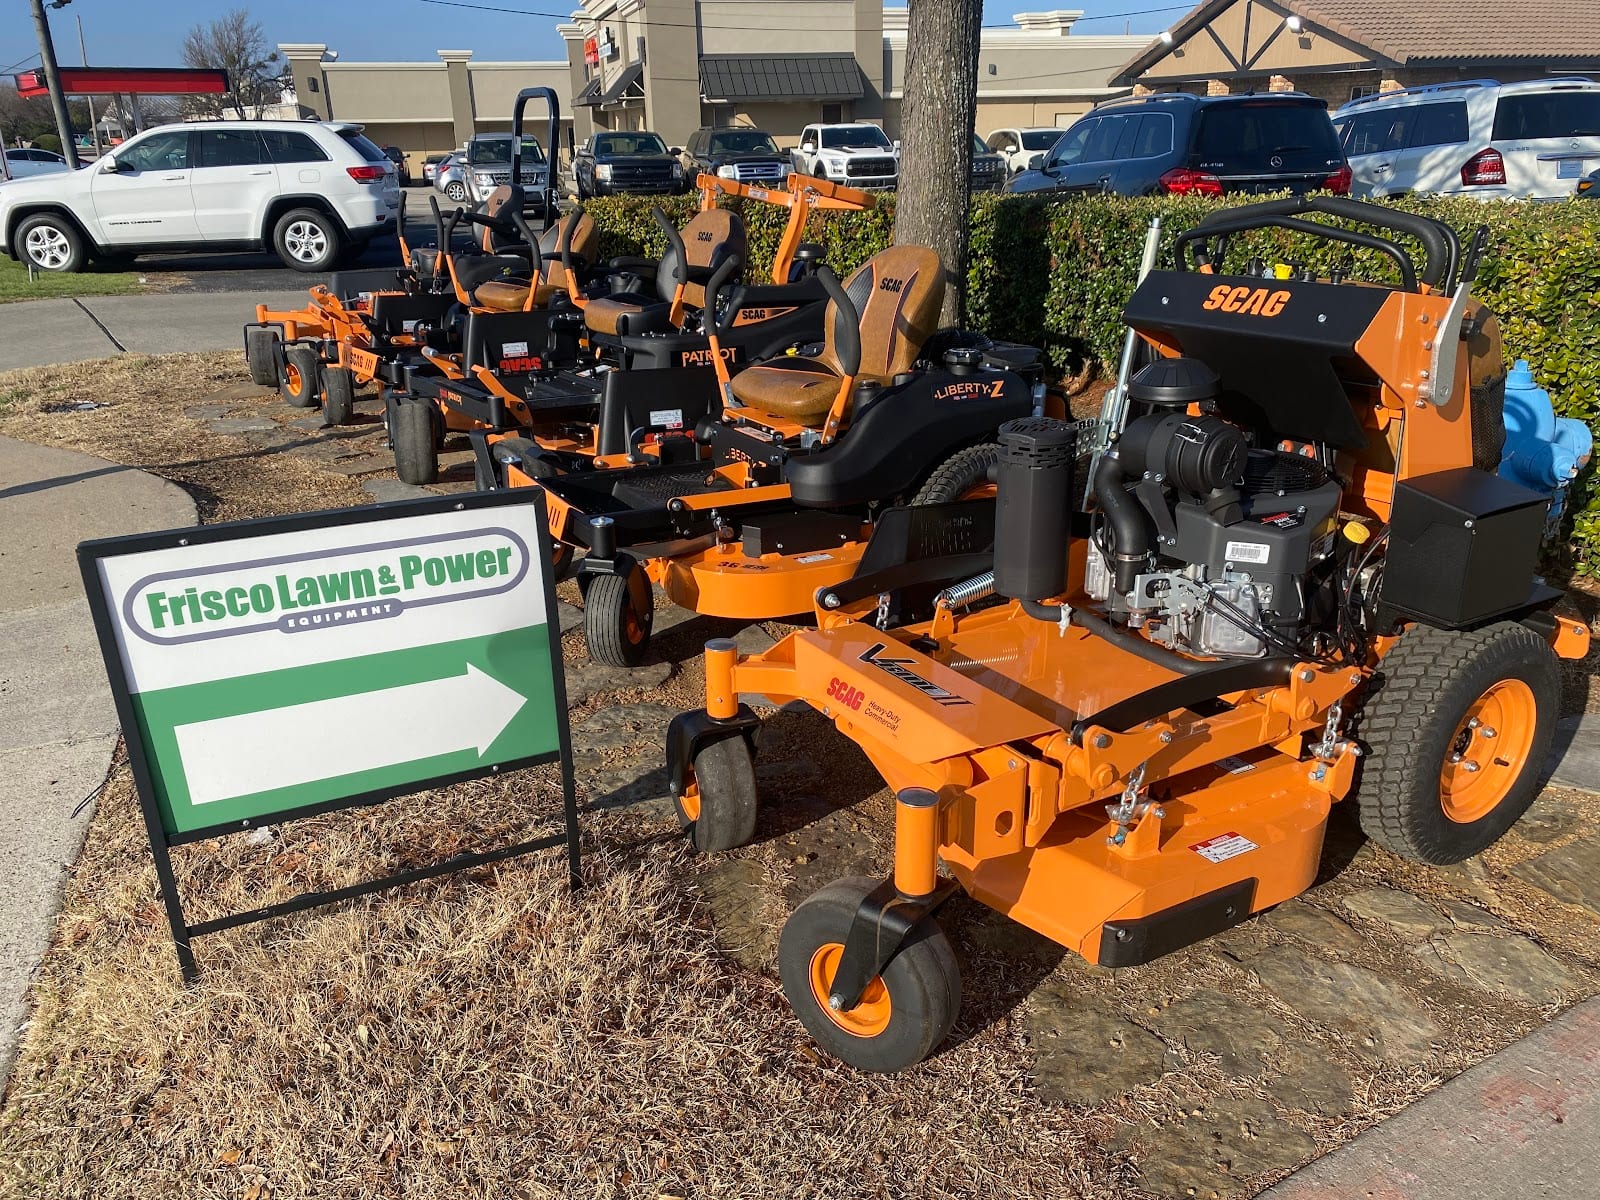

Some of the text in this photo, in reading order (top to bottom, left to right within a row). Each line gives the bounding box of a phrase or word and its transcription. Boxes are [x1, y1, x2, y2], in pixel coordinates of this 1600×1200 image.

[697, 231, 713, 242] SCAG
[879, 277, 903, 293] SCAG
[1202, 284, 1292, 317] SCAG
[742, 309, 766, 320] SCAG
[681, 347, 737, 367] PATROT
[146, 546, 512, 629] Frisco Lawn & Power
[287, 603, 392, 628] EQUIPMENT
[826, 676, 865, 712] SCAG
[864, 707, 899, 733] Commercial
[867, 700, 902, 724] Heavy-Duty
